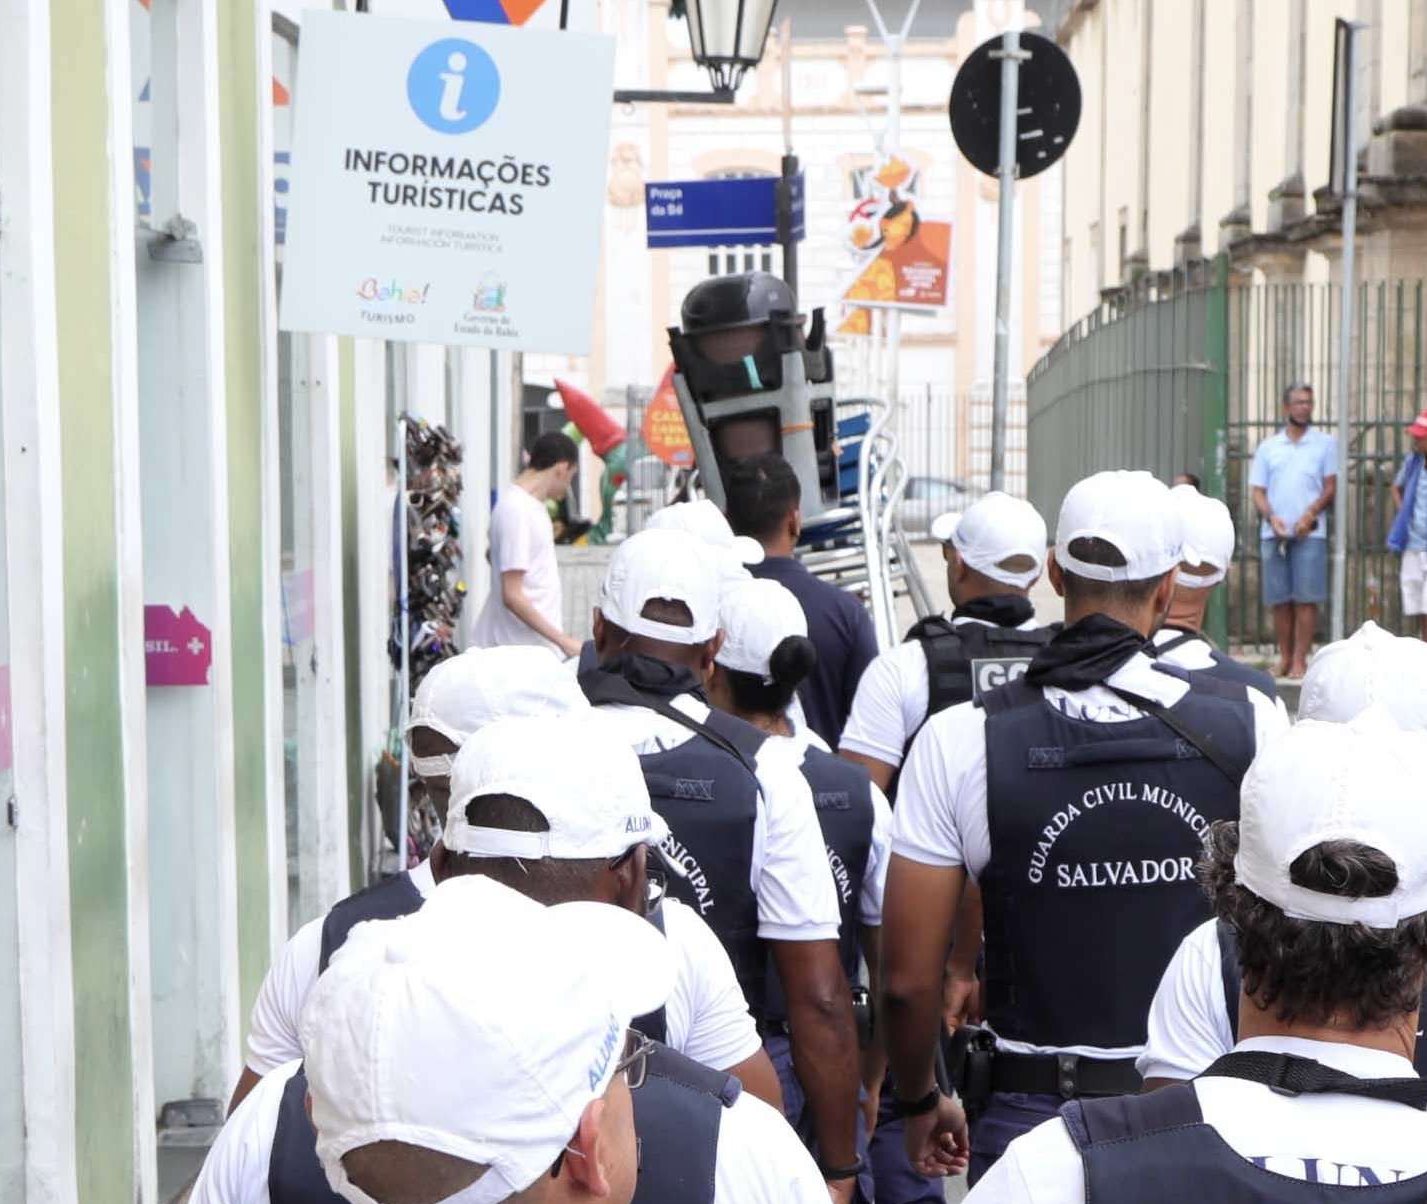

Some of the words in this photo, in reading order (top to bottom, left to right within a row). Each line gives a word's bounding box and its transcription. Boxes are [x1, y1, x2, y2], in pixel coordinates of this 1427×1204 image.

[344, 148, 551, 190] INFORMAÇÕES
[367, 179, 525, 216] TURÍSTICAS
[360, 309, 416, 325] TURISMO
[1028, 803, 1082, 884] GUARDA
[1083, 782, 1138, 809] CIVIL
[1142, 783, 1216, 852] MUNICI
[661, 832, 715, 915] NICIPAL
[1056, 856, 1196, 888] SALVADOR
